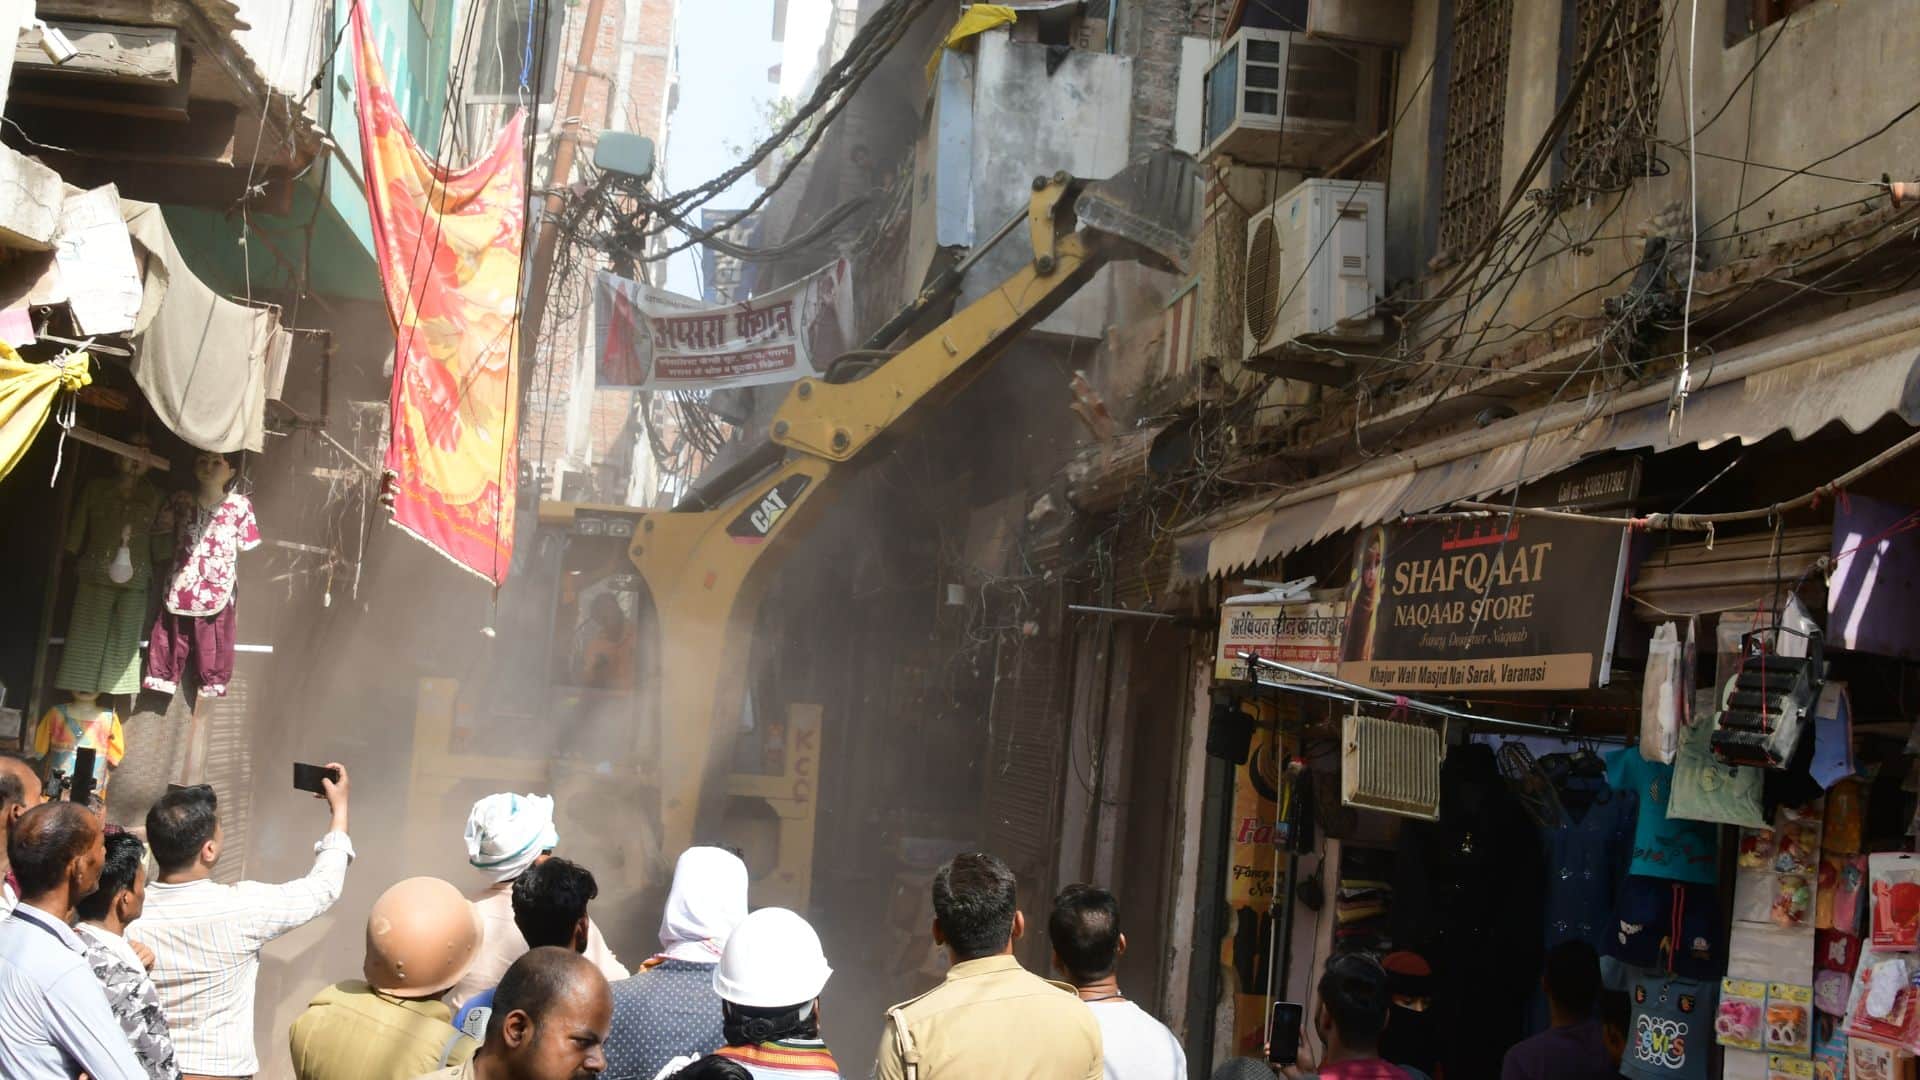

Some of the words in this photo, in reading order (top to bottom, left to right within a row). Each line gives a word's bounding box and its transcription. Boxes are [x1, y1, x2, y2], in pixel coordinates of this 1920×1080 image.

[652, 316, 727, 349] अप्सरा
[750, 487, 788, 534] CAT
[1392, 542, 1552, 596] SHAFQAAT
[1393, 602, 1465, 628] NAQAAB
[1469, 594, 1535, 623] STORE
[1369, 663, 1396, 688] Khajur
[1397, 664, 1417, 684] Wali
[1418, 662, 1450, 688] Masjid
[1450, 664, 1465, 683] Nai
[1466, 662, 1497, 684] Sarak,
[1501, 661, 1546, 681] Varanasi
